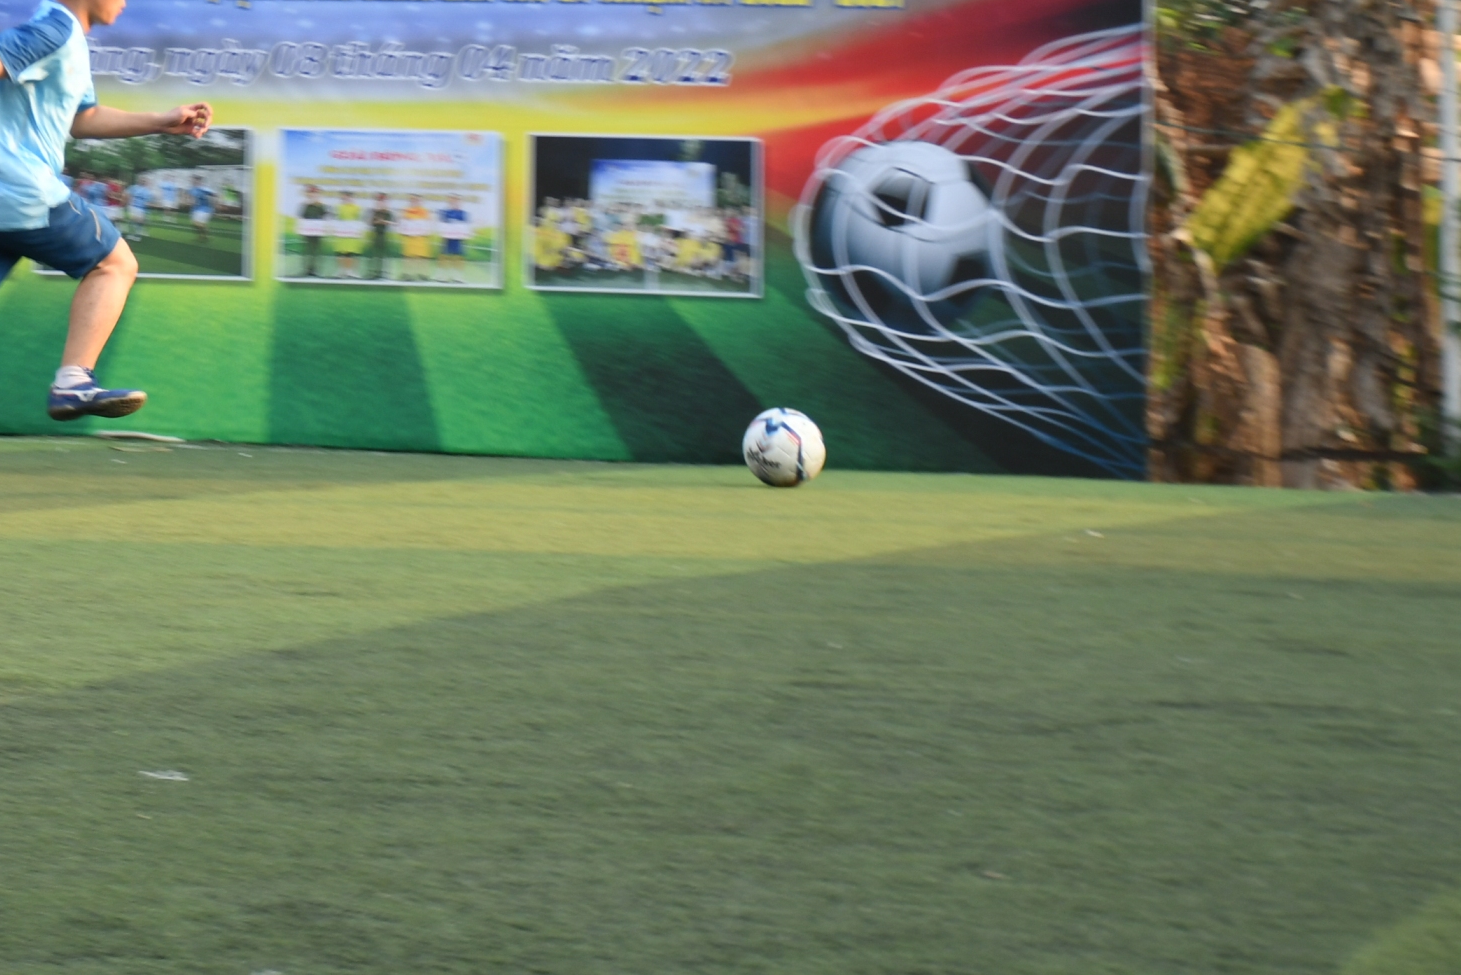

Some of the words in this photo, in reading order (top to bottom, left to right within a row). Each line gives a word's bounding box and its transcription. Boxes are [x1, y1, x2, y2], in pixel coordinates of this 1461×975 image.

[163, 38, 269, 86] ngày
[269, 40, 328, 79] 08
[330, 41, 453, 90] tháng
[457, 43, 516, 82] 04
[517, 43, 615, 83] năm
[620, 46, 734, 87] 2022
